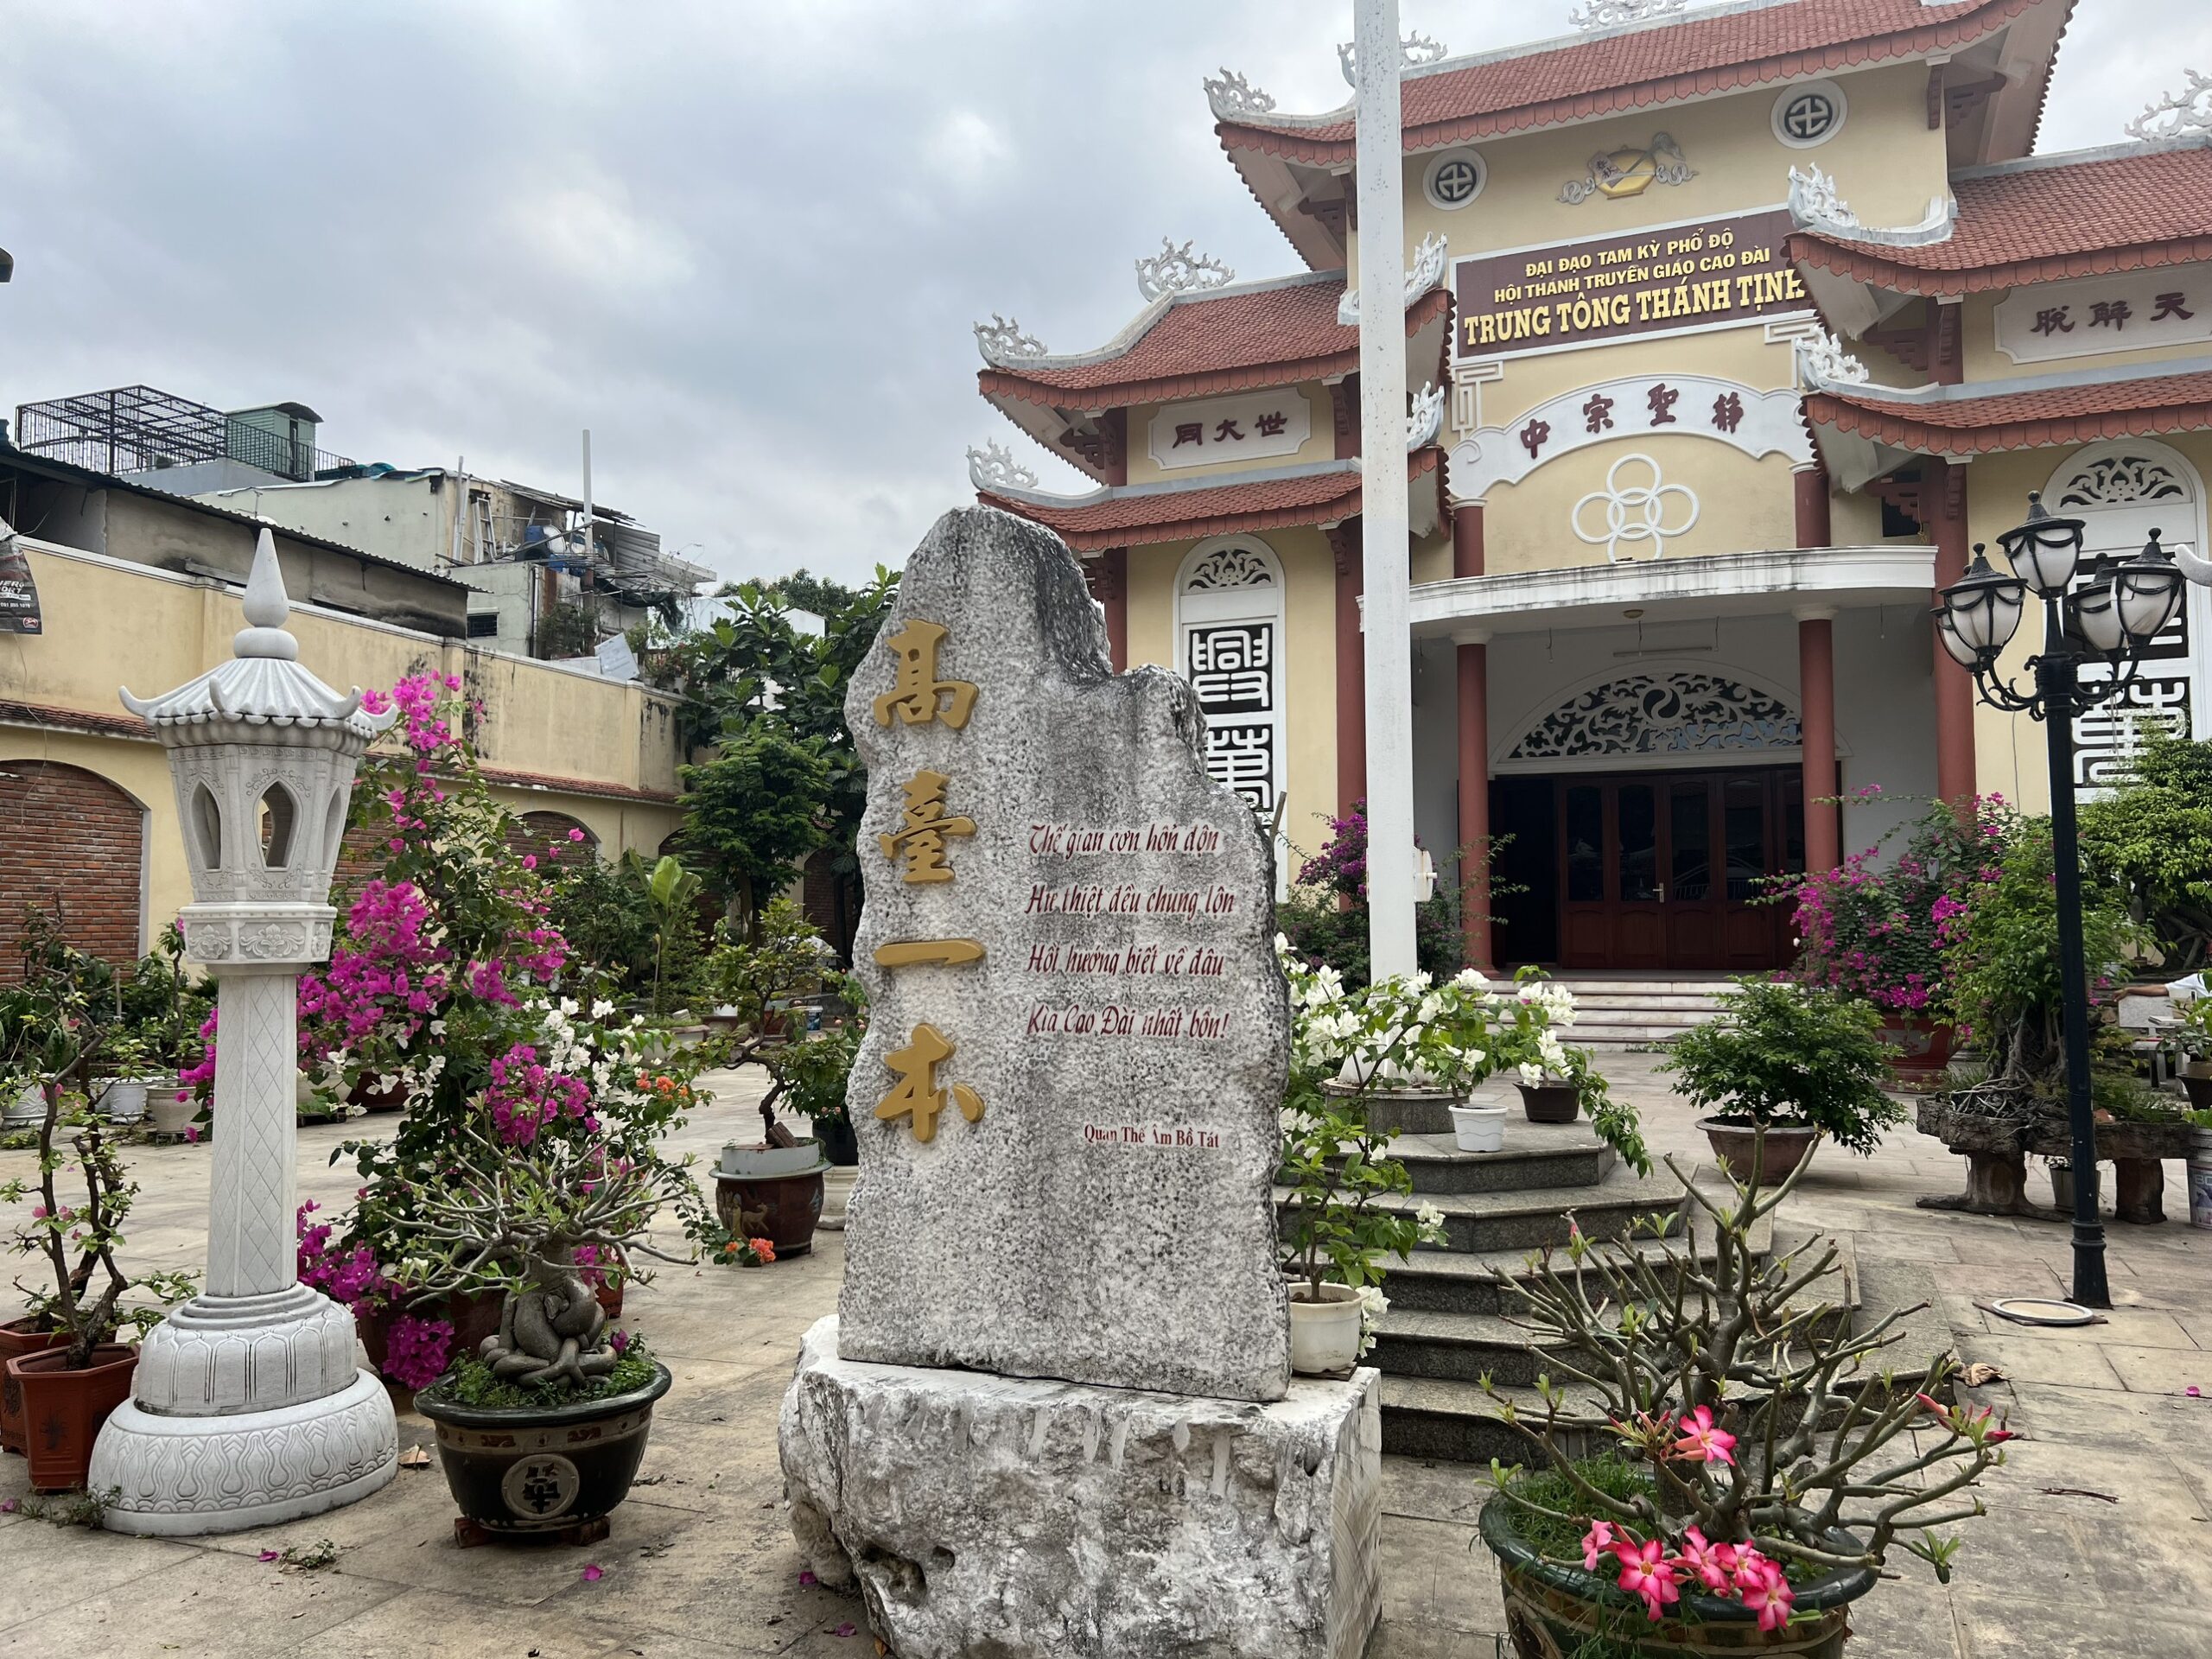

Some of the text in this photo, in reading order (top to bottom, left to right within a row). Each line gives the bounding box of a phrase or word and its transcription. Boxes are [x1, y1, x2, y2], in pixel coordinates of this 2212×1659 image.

[1525, 227, 1734, 278] ĐẠI ĐẠO TAM KỲ PHỔ ĐỘ
[1494, 283, 1522, 305] HỘI
[1524, 277, 1580, 298] THÁNH
[1653, 257, 1695, 279] GIÁO
[1700, 253, 1736, 272] CAO
[1740, 245, 1770, 266] ĐÀI
[1464, 305, 1552, 346] TRUNG
[1556, 291, 1631, 333] TÔNG
[1636, 276, 1732, 321] THÁNH
[1029, 823, 1068, 855] Thế
[1065, 827, 1104, 860] gian
[1061, 884, 1104, 918] thiệt
[1108, 884, 1141, 913] đều
[1146, 885, 1199, 921] chung
[1205, 885, 1235, 919] lộn
[1026, 943, 1060, 974] Hồi
[1125, 944, 1159, 975] biết
[1165, 945, 1188, 976] về
[1188, 946, 1224, 976] đâu
[1027, 1004, 1058, 1035] Kìa
[1064, 1004, 1095, 1033] Cao
[1101, 1005, 1136, 1035] Đài
[1141, 1007, 1183, 1037] nhất
[1084, 1123, 1219, 1147] Quan Thế Âm Bồ Tát
